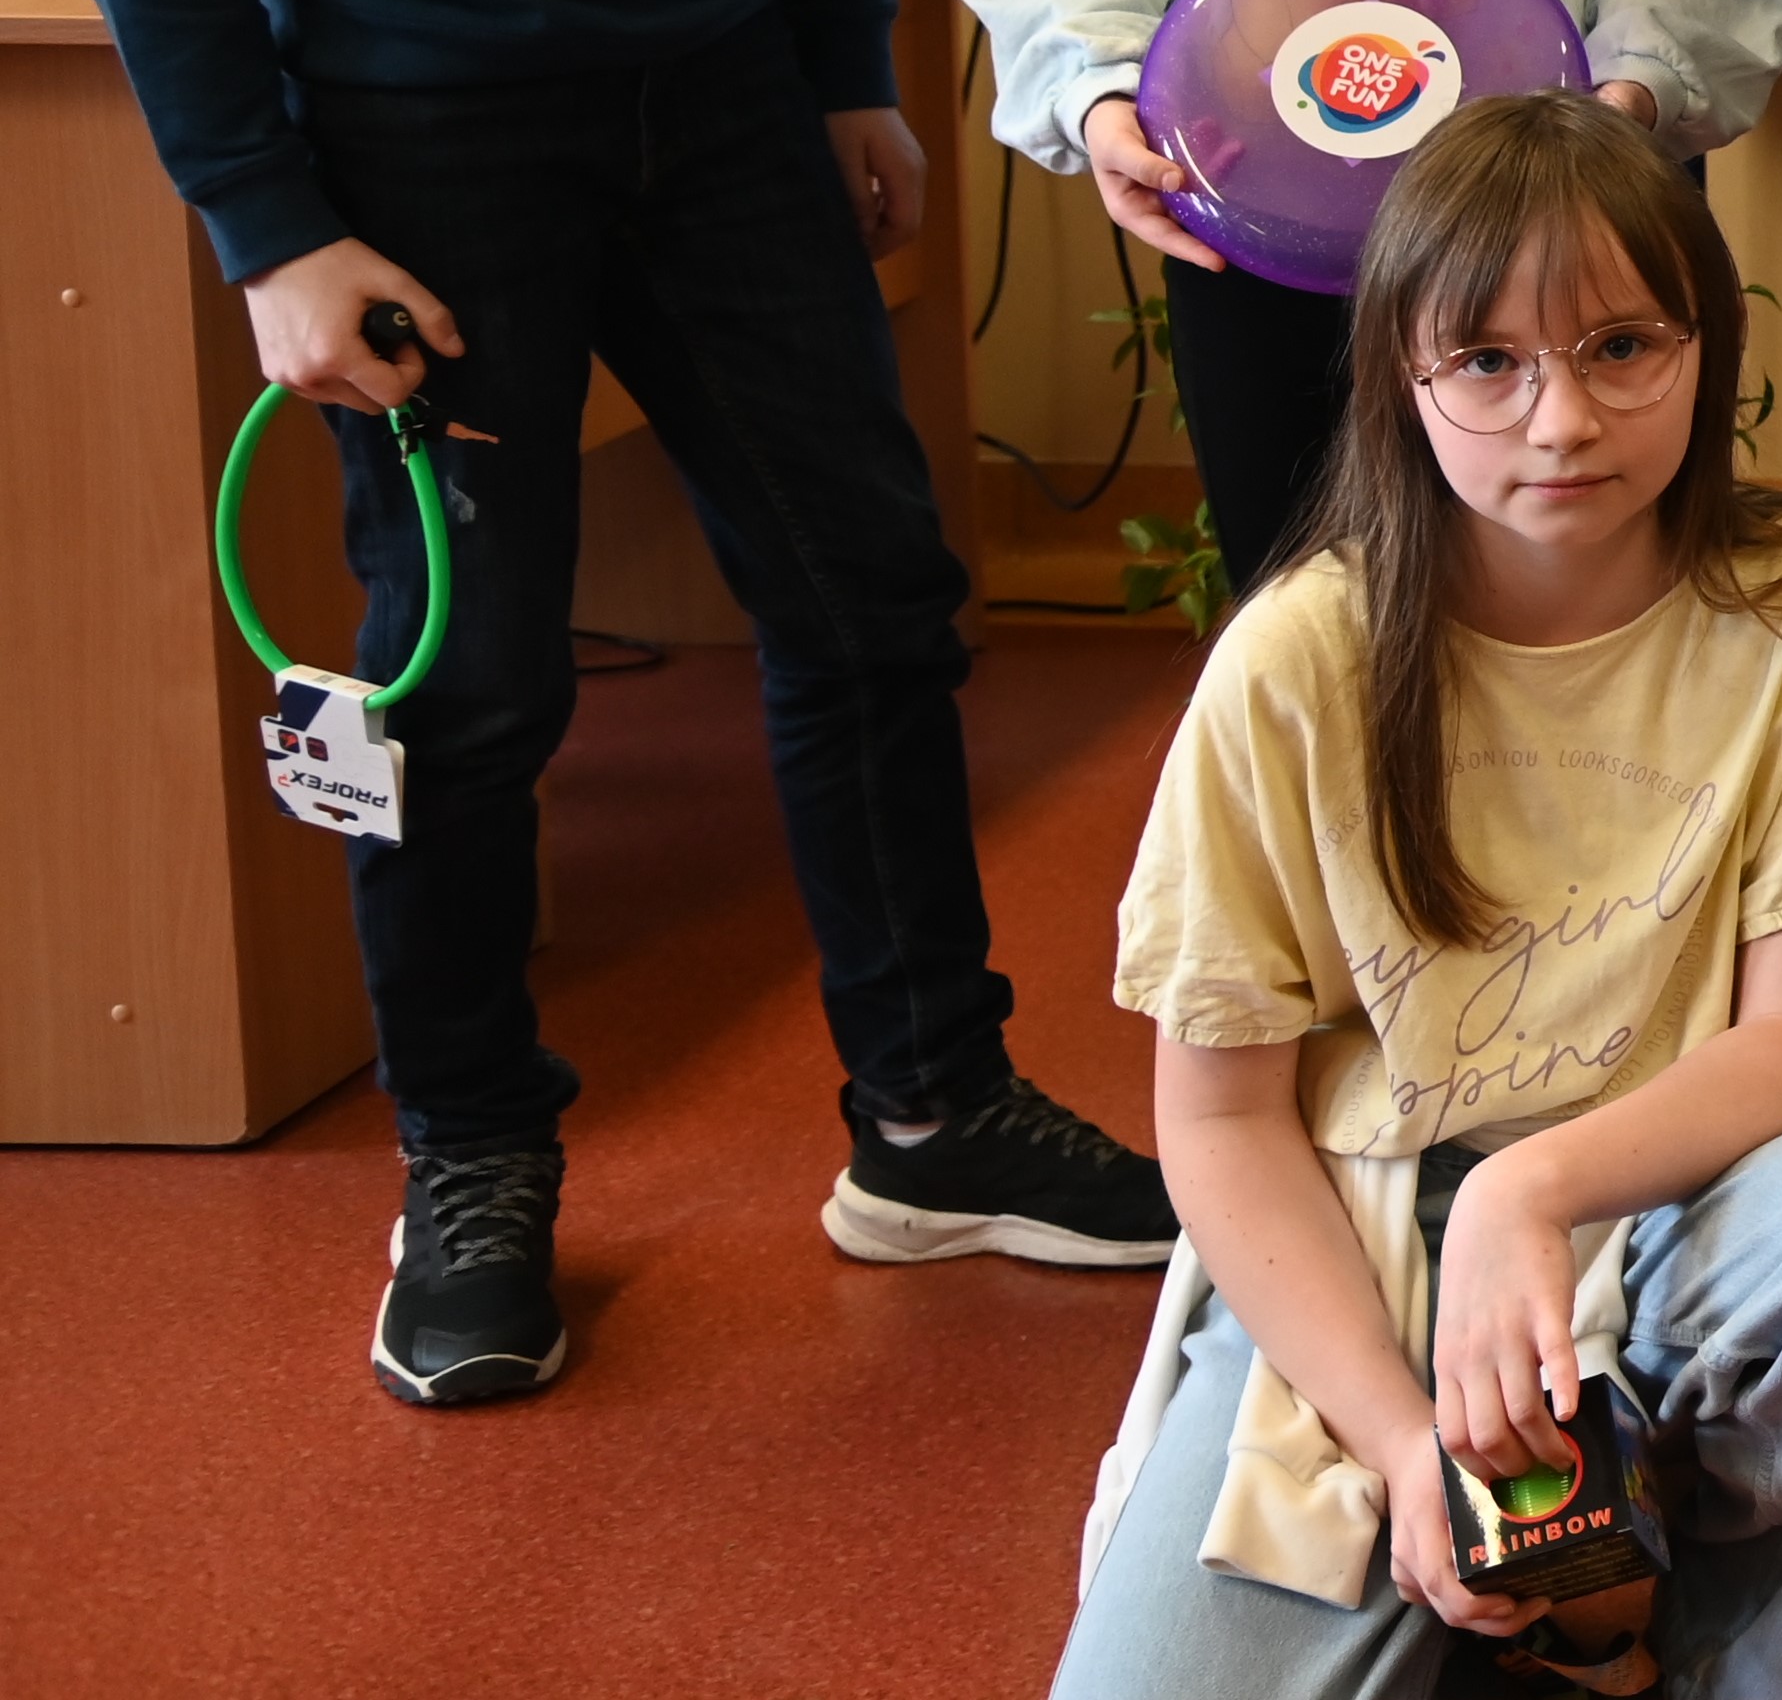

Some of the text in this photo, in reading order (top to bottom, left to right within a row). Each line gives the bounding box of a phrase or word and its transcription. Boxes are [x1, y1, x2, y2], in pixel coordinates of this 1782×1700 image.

[1336, 58, 1397, 94] TWO
[1342, 43, 1407, 79] ONE
[1329, 78, 1390, 112] FUN
[290, 770, 389, 809] PROFEX
[1455, 781, 1718, 1056] girl
[1469, 1506, 1613, 1565] RAINBOW
